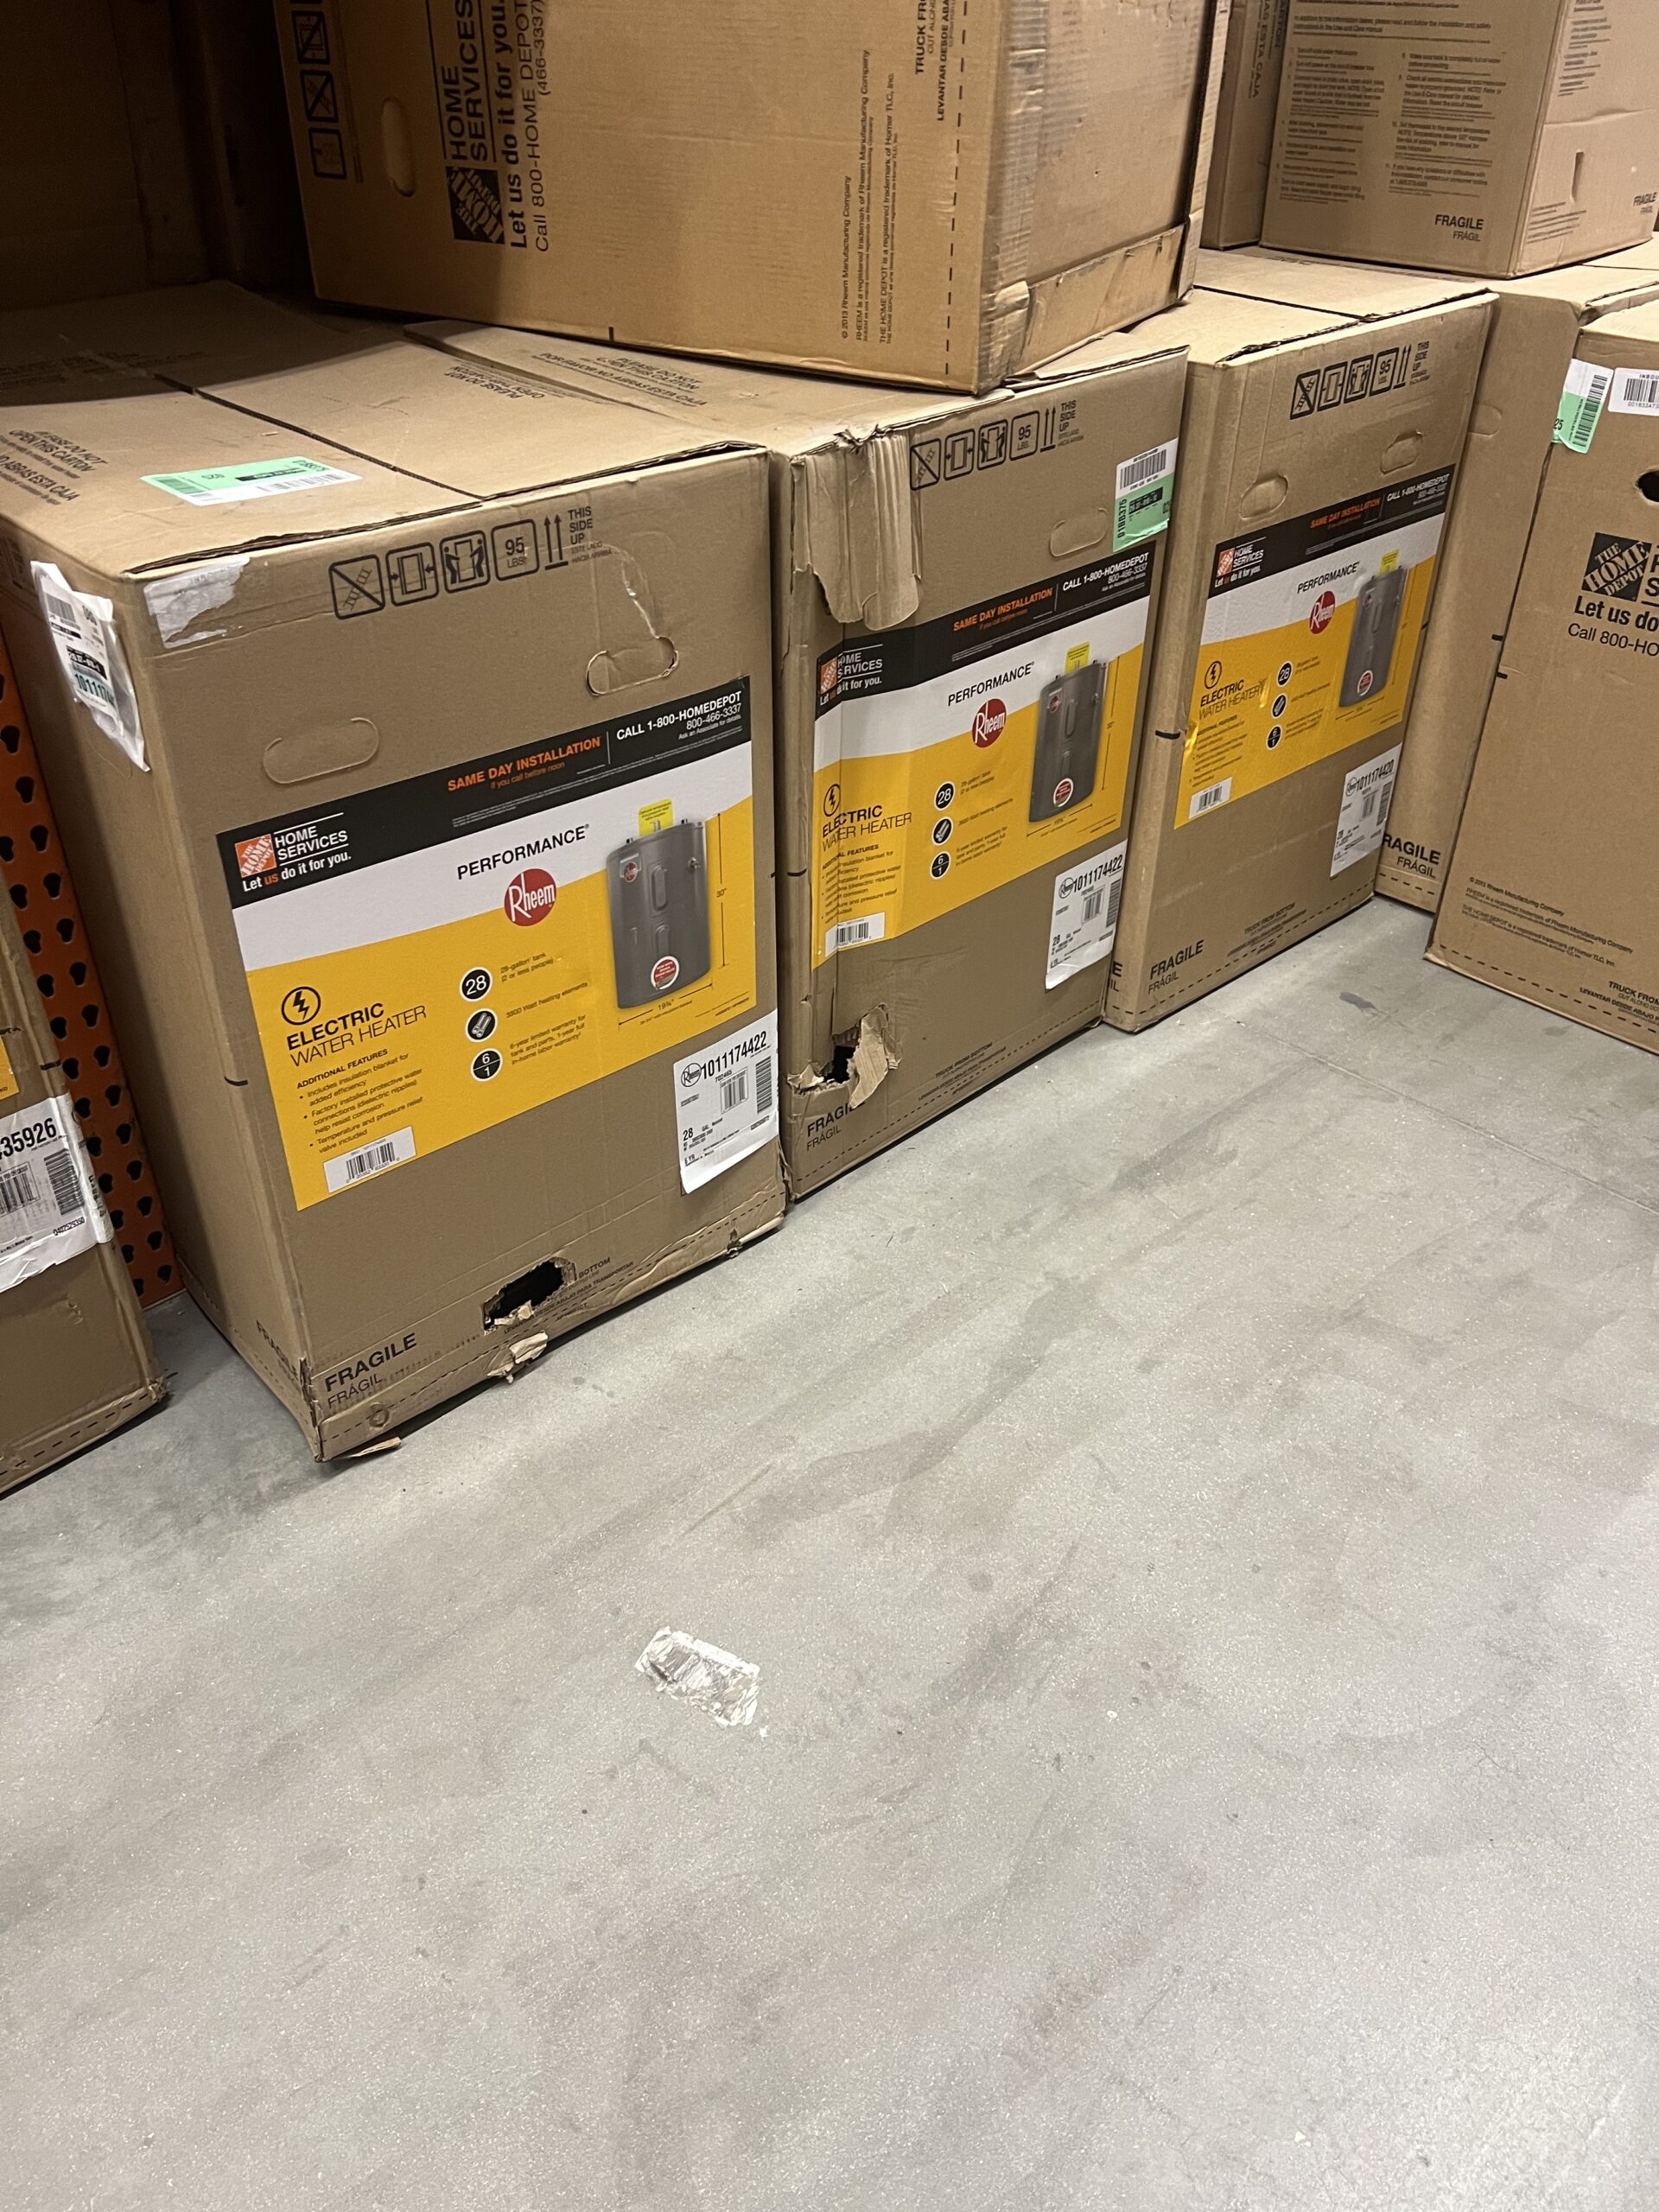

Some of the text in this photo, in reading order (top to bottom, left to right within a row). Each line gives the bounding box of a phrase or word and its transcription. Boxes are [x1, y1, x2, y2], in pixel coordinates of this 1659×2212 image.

[916, 25, 926, 75] TRUCK
[455, 0, 487, 162] SERVICES
[495, 62, 513, 99] for
[860, 50, 870, 94] Company
[938, 24, 950, 121] LEVANTAR DESDE
[441, 66, 467, 161] HOME
[498, 108, 515, 125] it
[501, 133, 518, 165] do
[522, 88, 544, 207] 800-HOME
[508, 174, 524, 202] us
[843, 175, 852, 217] Company
[1633, 192, 1657, 207] FRAGILE
[508, 210, 527, 248] Let
[533, 214, 549, 251] Call
[1434, 213, 1484, 230] FRAGILE
[842, 219, 851, 277] Manufacturing
[1059, 410, 1077, 423] SIDE
[1060, 399, 1077, 412] THIS
[1018, 423, 1032, 441] 95
[1058, 422, 1070, 432] UP
[1386, 489, 1402, 503] CALL
[568, 505, 592, 520] THIS
[569, 518, 594, 532] SIDE
[505, 537, 525, 556] 95
[570, 532, 586, 545] UP
[1234, 544, 1255, 558] HOME
[1594, 543, 1621, 564] THE
[1063, 577, 1082, 592] CALL
[1083, 551, 1150, 584] 1-800-HOMEDEPOT
[1232, 550, 1264, 568] SERVICES
[1584, 541, 1649, 592] HOME
[1297, 563, 1357, 594] PERFORMANCE
[1604, 564, 1644, 596] DEPOT
[953, 615, 977, 632] SAME
[979, 608, 996, 622] DAY
[996, 588, 1053, 616] INSTALLATION
[1574, 595, 1659, 632] Let us do
[1567, 622, 1659, 657] Call 800-HO
[850, 676, 883, 690] for you.
[947, 663, 1033, 707] PERFORMANCE
[1278, 667, 1291, 683] 28
[1200, 679, 1245, 708] ELECTRIC
[616, 690, 742, 741] CALL 1-800-HOMEDEPOT
[686, 702, 742, 730] 800-466-3337
[974, 702, 1006, 744] Rheem
[1198, 699, 1227, 721] WATER
[678, 732, 689, 741] Ask
[448, 736, 601, 791] SAME DAY INSTALLATION
[497, 761, 566, 789] you call before noon
[937, 787, 952, 805] 28
[274, 825, 319, 849] HOME
[822, 804, 883, 839] ELECTRIC
[860, 811, 912, 836] HEATER
[277, 830, 349, 861] SERVICES
[457, 824, 587, 880] PERFORMANCE
[847, 843, 880, 857] FEATURES
[938, 855, 944, 865] 6
[1382, 832, 1441, 866] RAGILE
[242, 851, 352, 893] Let us do it for you.
[938, 867, 944, 876] 1
[1073, 854, 1123, 893] 1011174422
[1396, 855, 1437, 879] FRÁGIL
[506, 872, 556, 923] Rheem
[1149, 938, 1205, 981] FRAGILE
[466, 974, 487, 995] 28
[1147, 970, 1179, 995] FRÁGIL
[1579, 986, 1611, 1003] LEVANTAR
[1608, 980, 1637, 998] TRUCK
[537, 993, 561, 1007] heating
[286, 1002, 385, 1052] ELECTRIC
[289, 1005, 428, 1067] WATER HEATER
[296, 1048, 389, 1090] ADDITIONAL FEATURES
[481, 1052, 491, 1065] 6
[700, 1030, 767, 1080] 1011174422
[307, 1052, 410, 1098] Includes insulation blanket for
[484, 1065, 492, 1077] 1
[309, 1080, 366, 1108] added efficiency
[311, 1067, 423, 1118] Factory installed protective water
[313, 1103, 357, 1127] connections
[315, 1101, 385, 1136] help resist corrosion
[316, 1096, 424, 1146] Temperature and pressure relief
[807, 1101, 867, 1138] FRAGI
[0, 1117, 57, 1160] 35926
[318, 1128, 369, 1154] valve included
[682, 1127, 695, 1141] 28
[576, 1261, 635, 1296] PARA TRANSPORTAR
[578, 1256, 612, 1280] BOTTOM
[324, 1332, 418, 1393] FRAGILE
[327, 1372, 384, 1409] FRÁGIL
